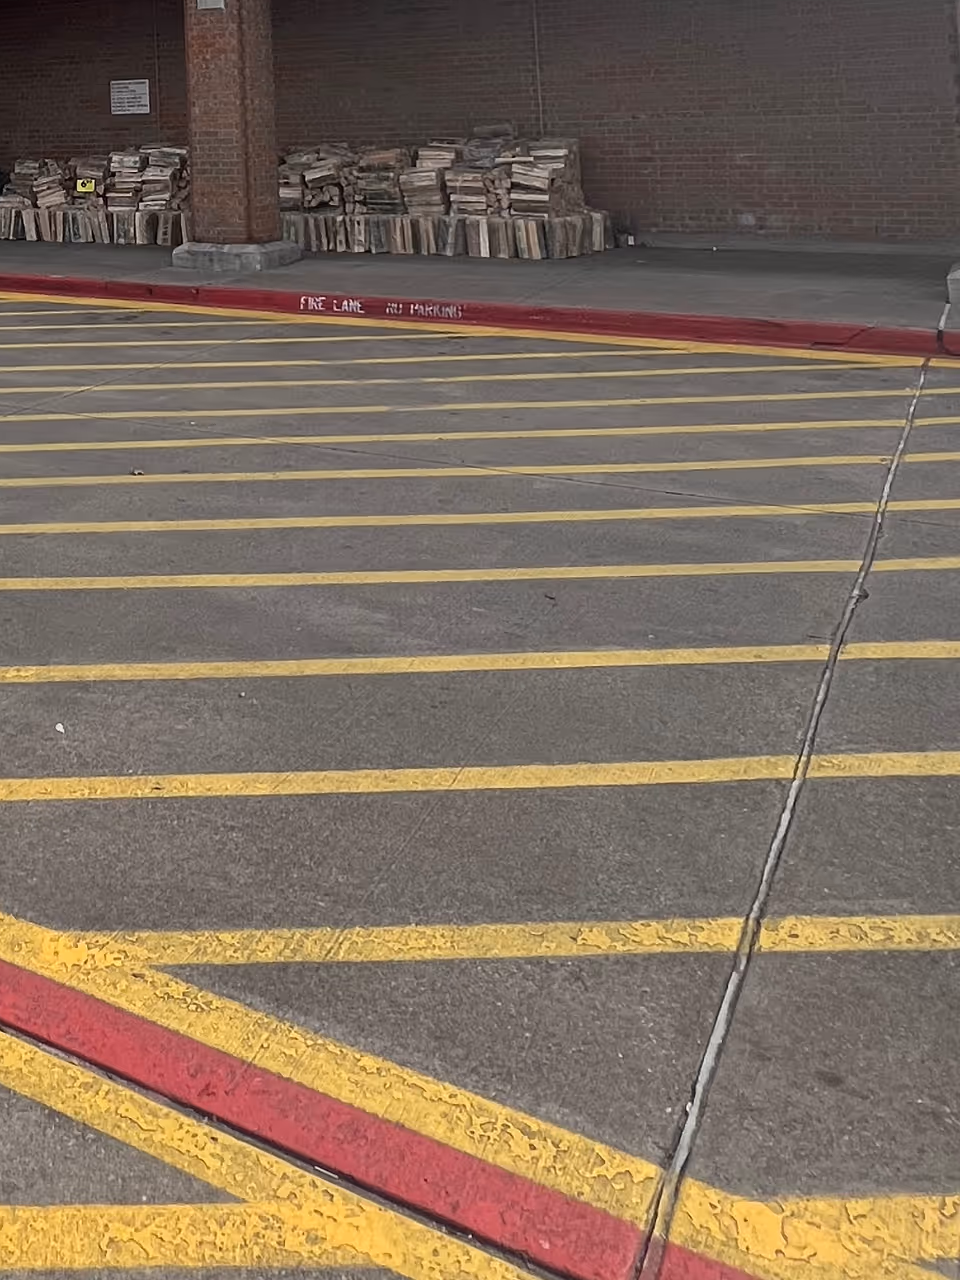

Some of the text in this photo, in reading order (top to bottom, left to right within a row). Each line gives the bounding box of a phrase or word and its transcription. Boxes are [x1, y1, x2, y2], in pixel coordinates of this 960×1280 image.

[300, 296, 463, 318] FIRE LANE NO PARKING
